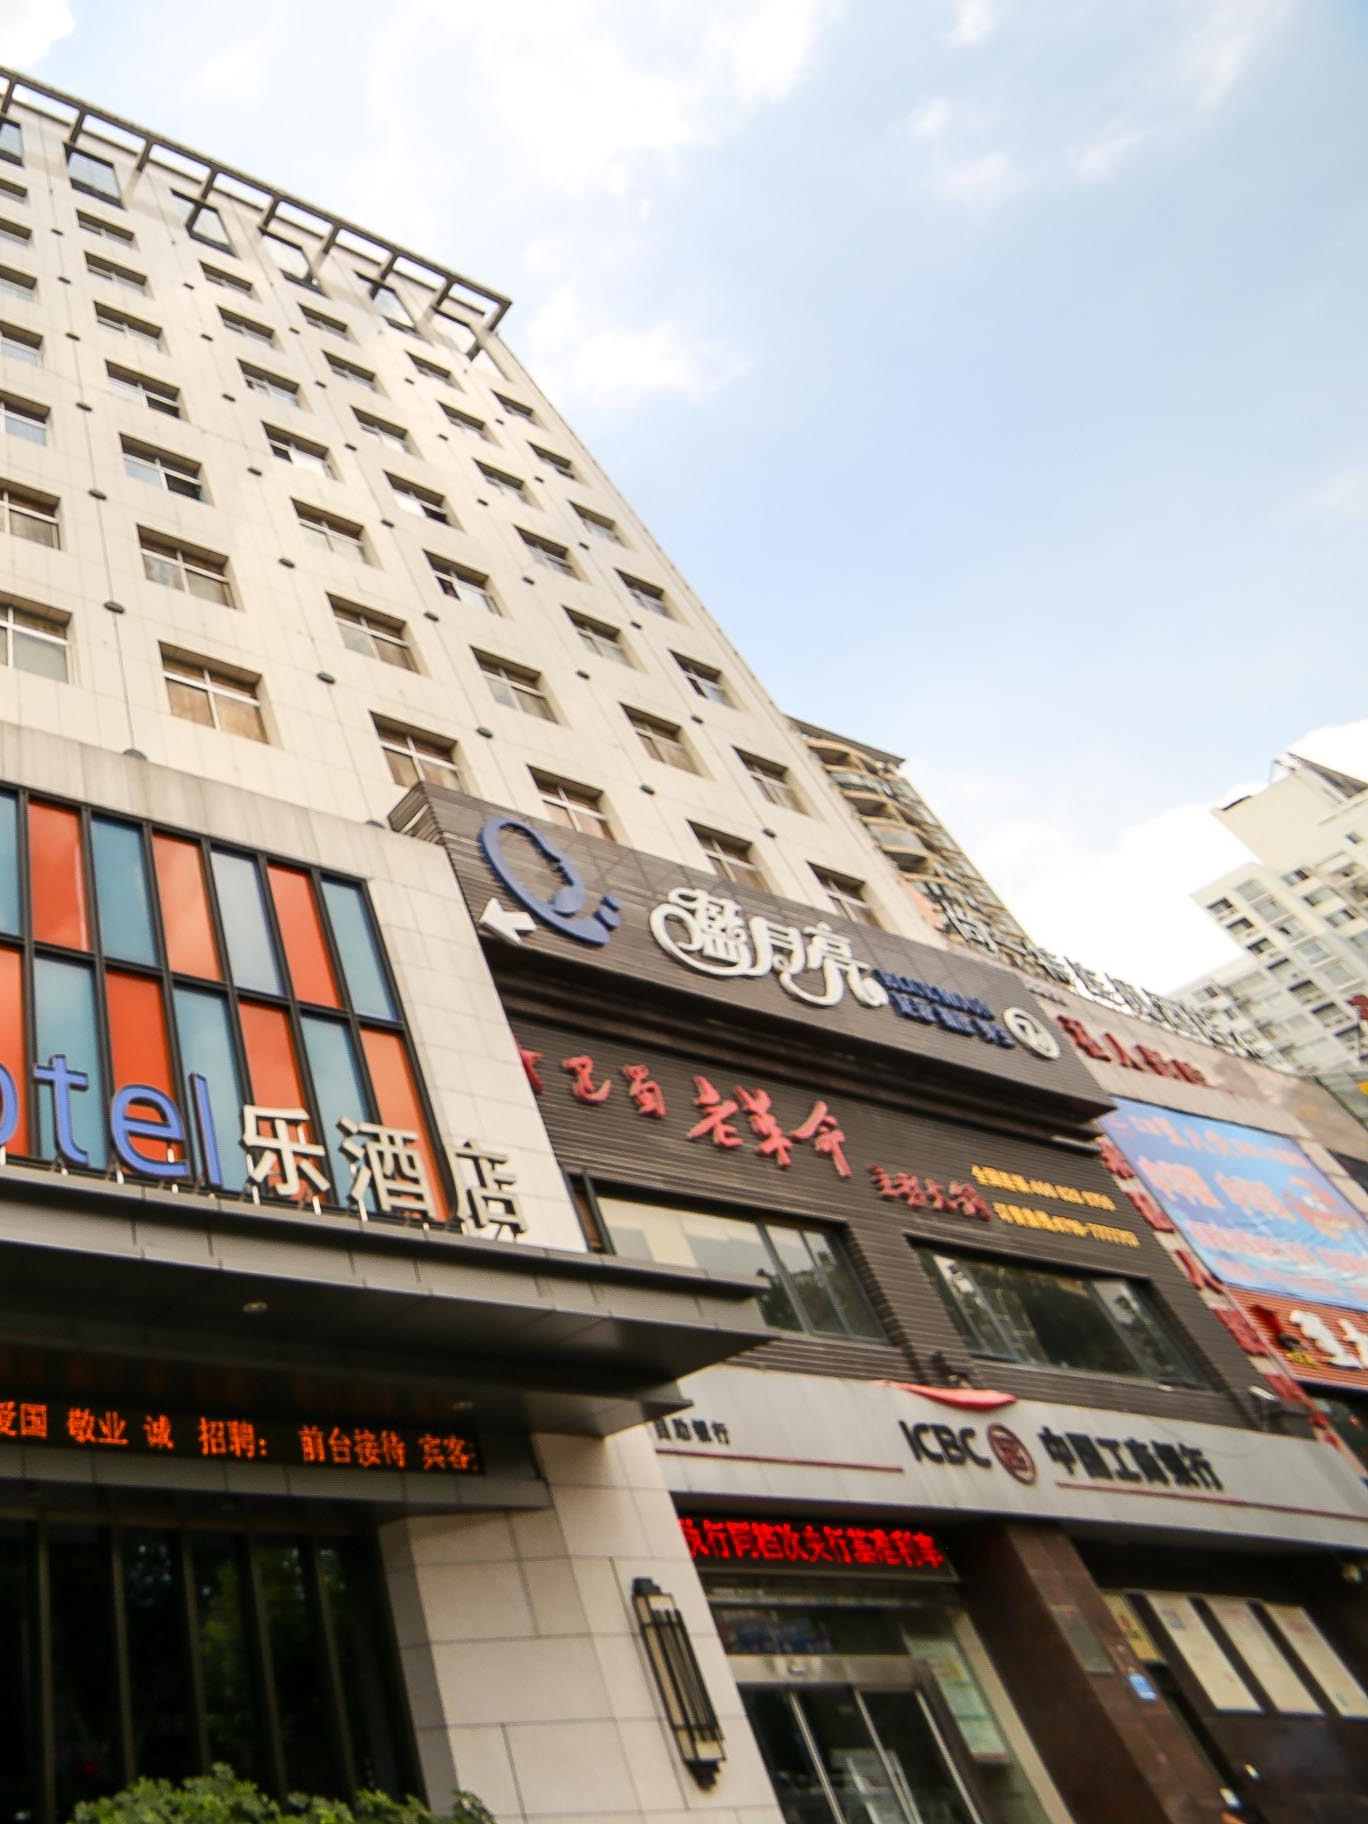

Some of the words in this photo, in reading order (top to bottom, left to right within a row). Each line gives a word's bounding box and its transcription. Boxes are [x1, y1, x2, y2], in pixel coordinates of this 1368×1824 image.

[241, 1104, 528, 1233] 乐酒店
[66, 1408, 129, 1445] 敬业
[143, 1414, 174, 1449] 诚
[298, 1424, 406, 1468] 前台接待
[898, 1419, 991, 1469] ICBC
[1036, 1425, 1224, 1490] 中国工商银行
